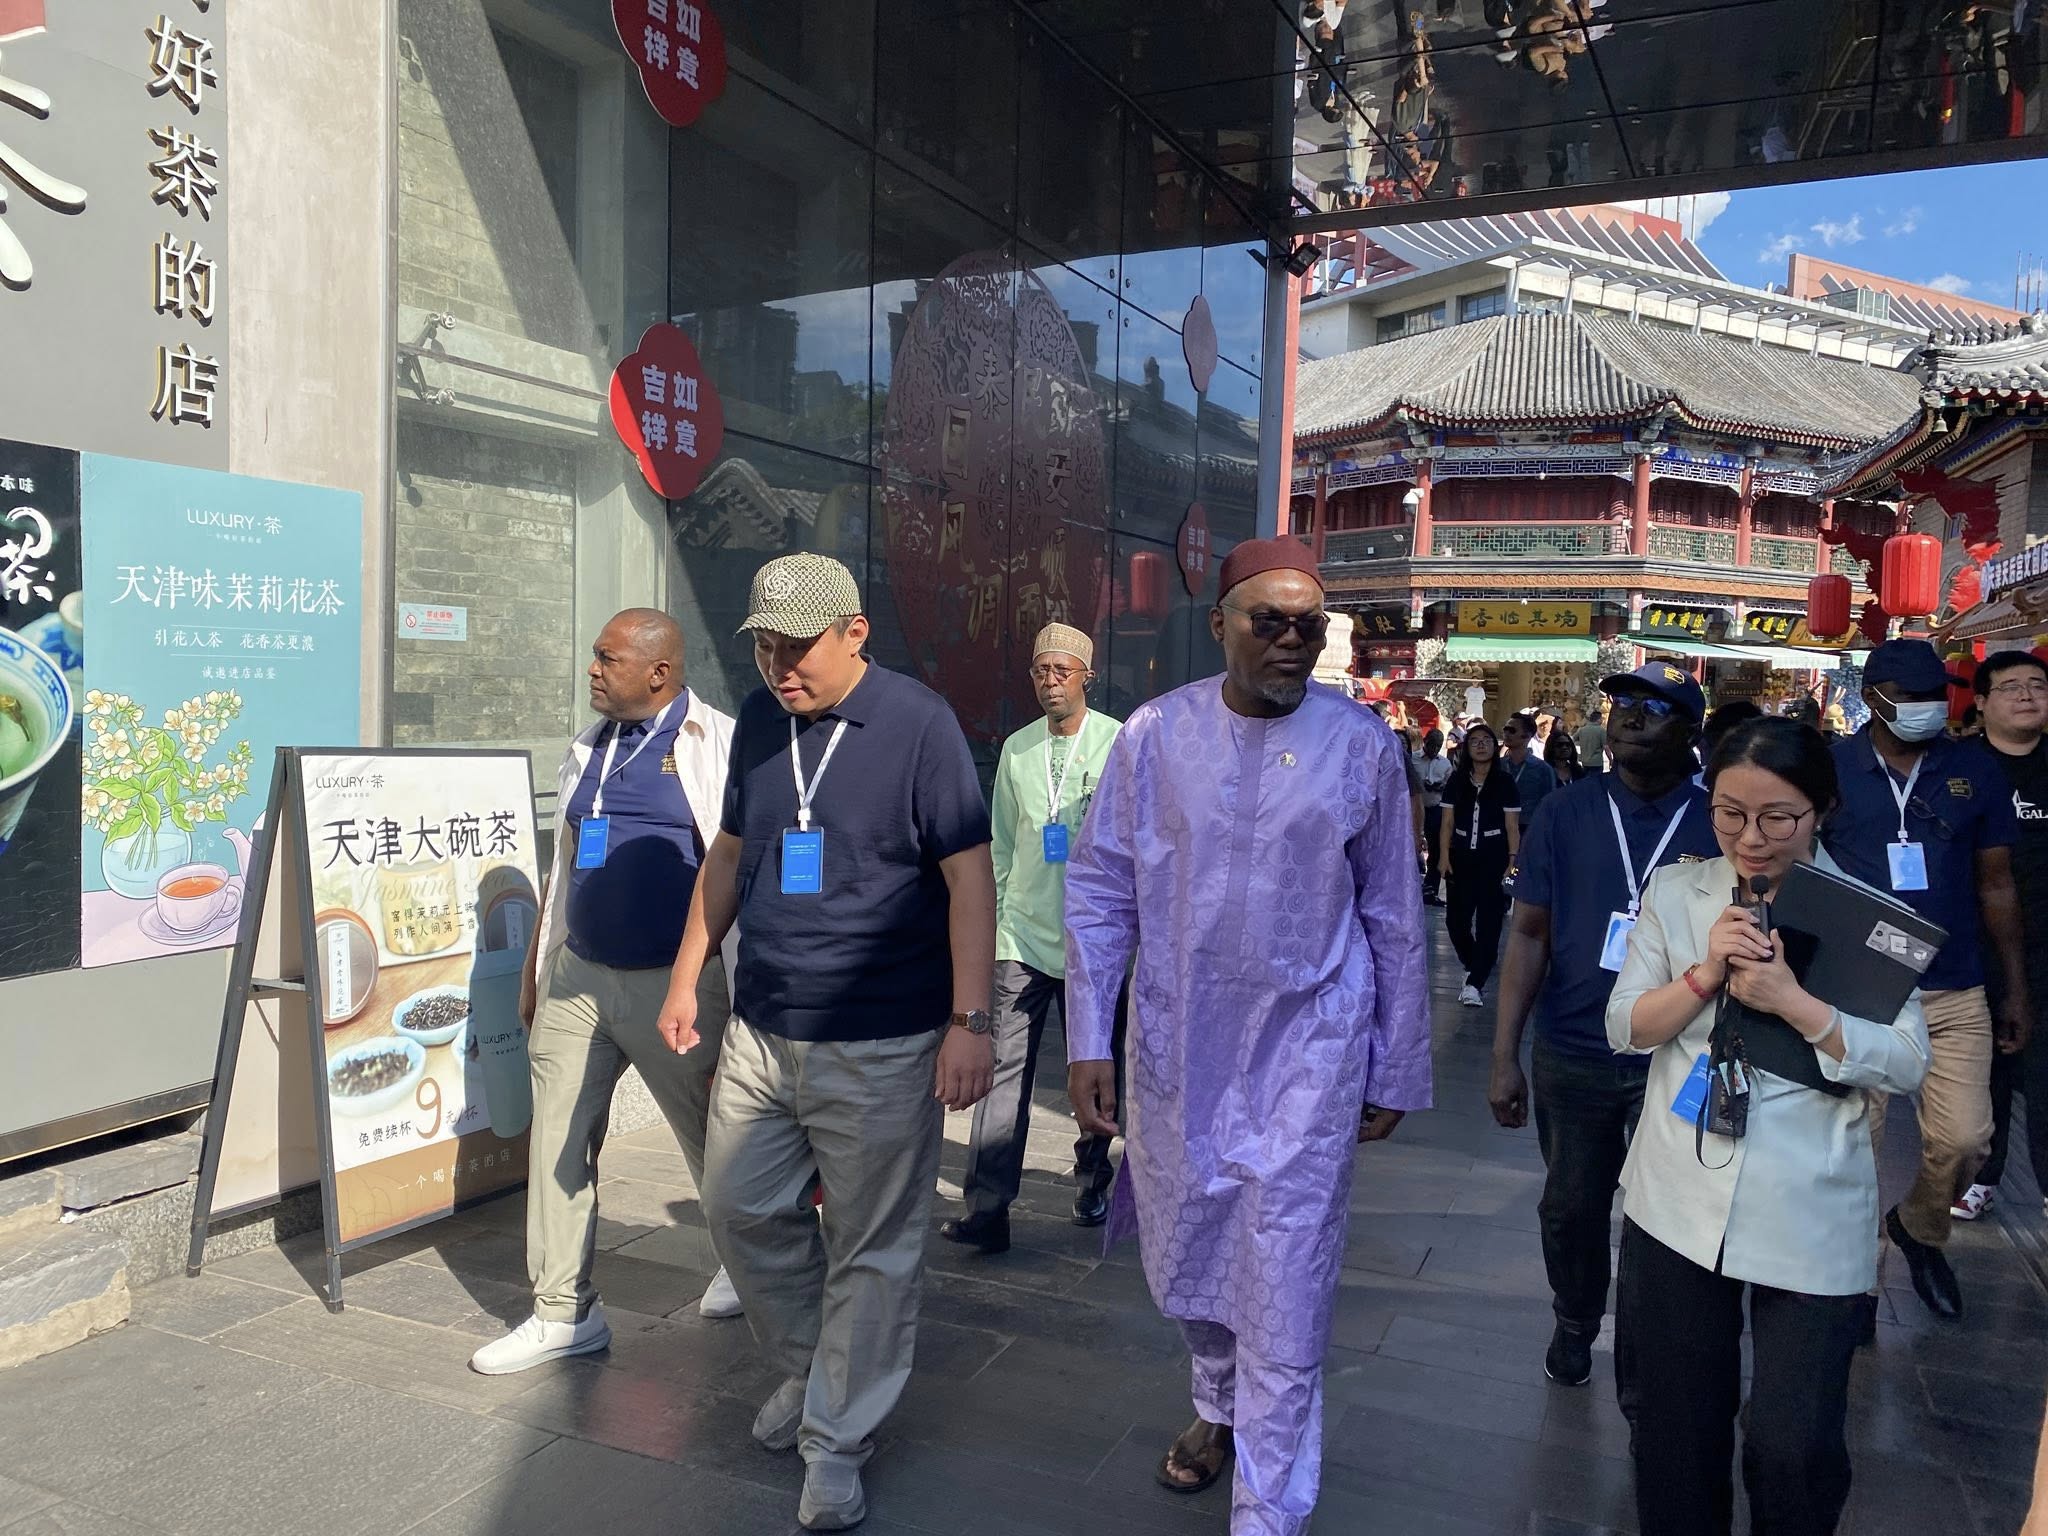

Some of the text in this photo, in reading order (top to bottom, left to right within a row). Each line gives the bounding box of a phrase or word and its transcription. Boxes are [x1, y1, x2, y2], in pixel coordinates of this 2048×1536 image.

[144, 0, 219, 428] 好茶的店
[642, 364, 668, 450] 吉祥
[673, 371, 698, 458] 如意
[110, 565, 345, 617] 天津味茉莉花茶
[154, 629, 224, 649] 引花入茶
[322, 810, 519, 869] 天津大碗茶
[358, 1120, 411, 1148] 免费续杯
[415, 1077, 442, 1139] 9
[398, 1150, 511, 1192] 一个喝好茶的店
